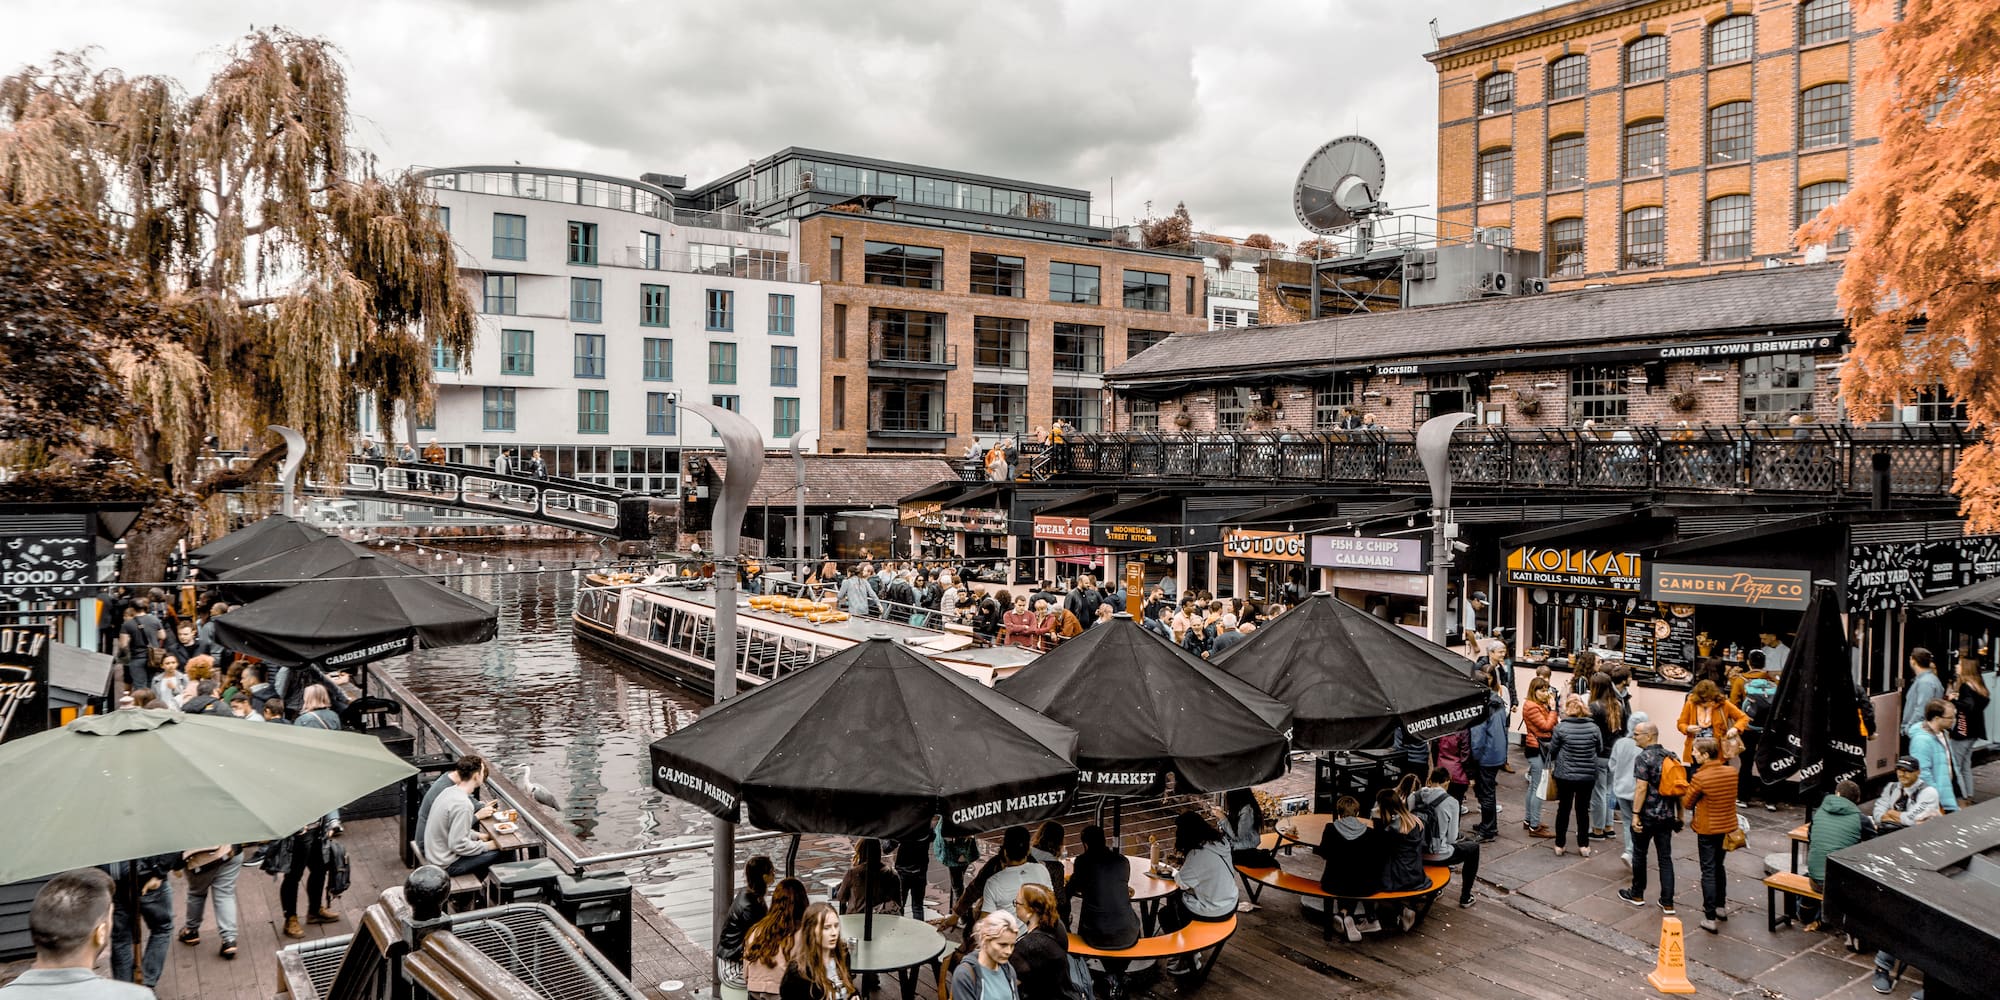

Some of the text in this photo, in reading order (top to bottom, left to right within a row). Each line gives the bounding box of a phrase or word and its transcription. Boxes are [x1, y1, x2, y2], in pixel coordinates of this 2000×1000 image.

[1660, 339, 1817, 358] CAMDEN TOWN BREWERY
[1378, 366, 1419, 375] LOCKSIDE
[1036, 524, 1065, 536] STEAK
[1131, 534, 1157, 543] KITCHEN
[1331, 539, 1399, 553] FISH & CHIPS
[1335, 554, 1394, 567] CALAMARI
[3, 570, 57, 585] FOOD
[1512, 571, 1533, 581] KATI
[1534, 572, 1562, 583] ROLLS
[1570, 575, 1598, 586] INDIA
[1861, 569, 1910, 586] WEST YARD
[1658, 572, 1803, 604] CAMDEN Pizza CO
[325, 637, 408, 665] CAMDEN MARKET
[1406, 704, 1484, 735] CAMDEN MARKET
[1096, 771, 1157, 785] MARKET
[658, 765, 736, 810] CAMDEN MARKET
[952, 789, 1066, 825] CAMDEN MARKET
